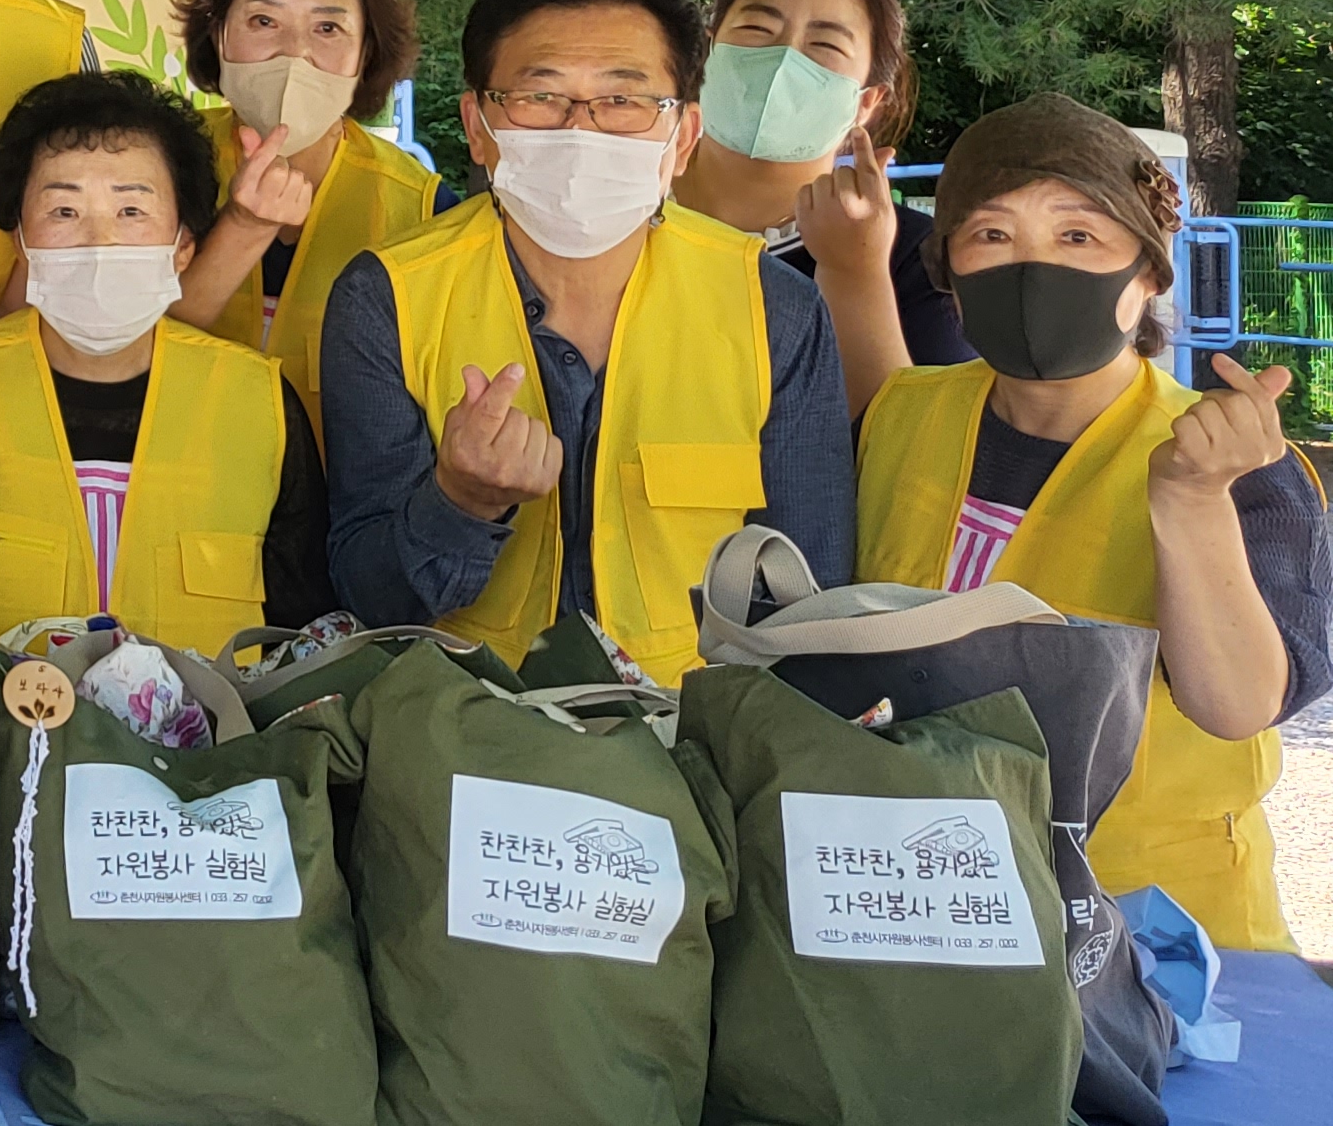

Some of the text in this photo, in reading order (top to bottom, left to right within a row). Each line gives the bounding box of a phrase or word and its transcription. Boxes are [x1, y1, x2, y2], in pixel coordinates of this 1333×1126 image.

[90, 810, 169, 839] 찬찬찬,
[96, 848, 268, 883] 자원봉사 실험실
[479, 830, 564, 872] 찬찬찬,
[814, 845, 906, 880] 찬찬찬,
[482, 878, 656, 927] 자원봉사 실험실
[823, 890, 1013, 925] 자원봉사 실험실
